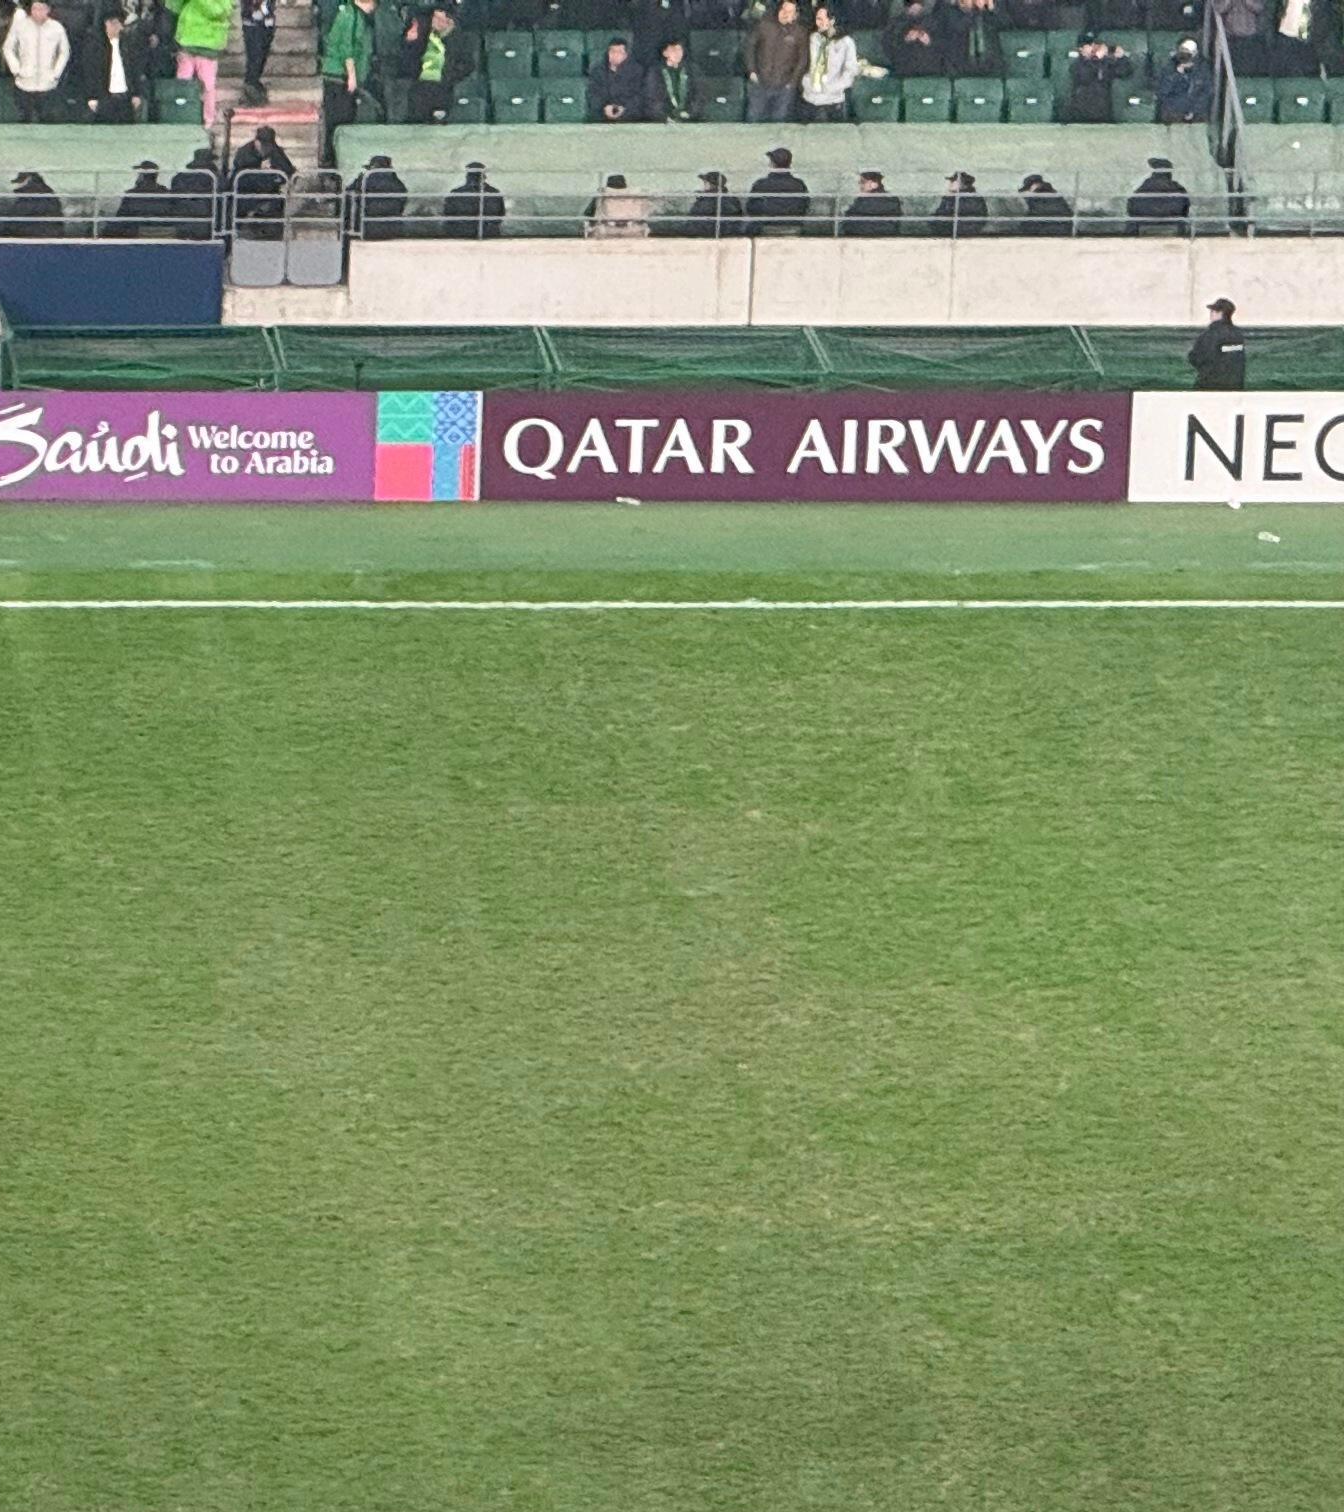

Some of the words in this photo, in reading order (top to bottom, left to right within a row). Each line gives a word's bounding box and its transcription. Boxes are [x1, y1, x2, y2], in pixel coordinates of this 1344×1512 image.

[187, 424, 315, 451] Welcome
[502, 417, 755, 481] QATAR
[786, 418, 1106, 474] AIRWAYS
[211, 451, 239, 475] to
[244, 449, 334, 476] Arabia
